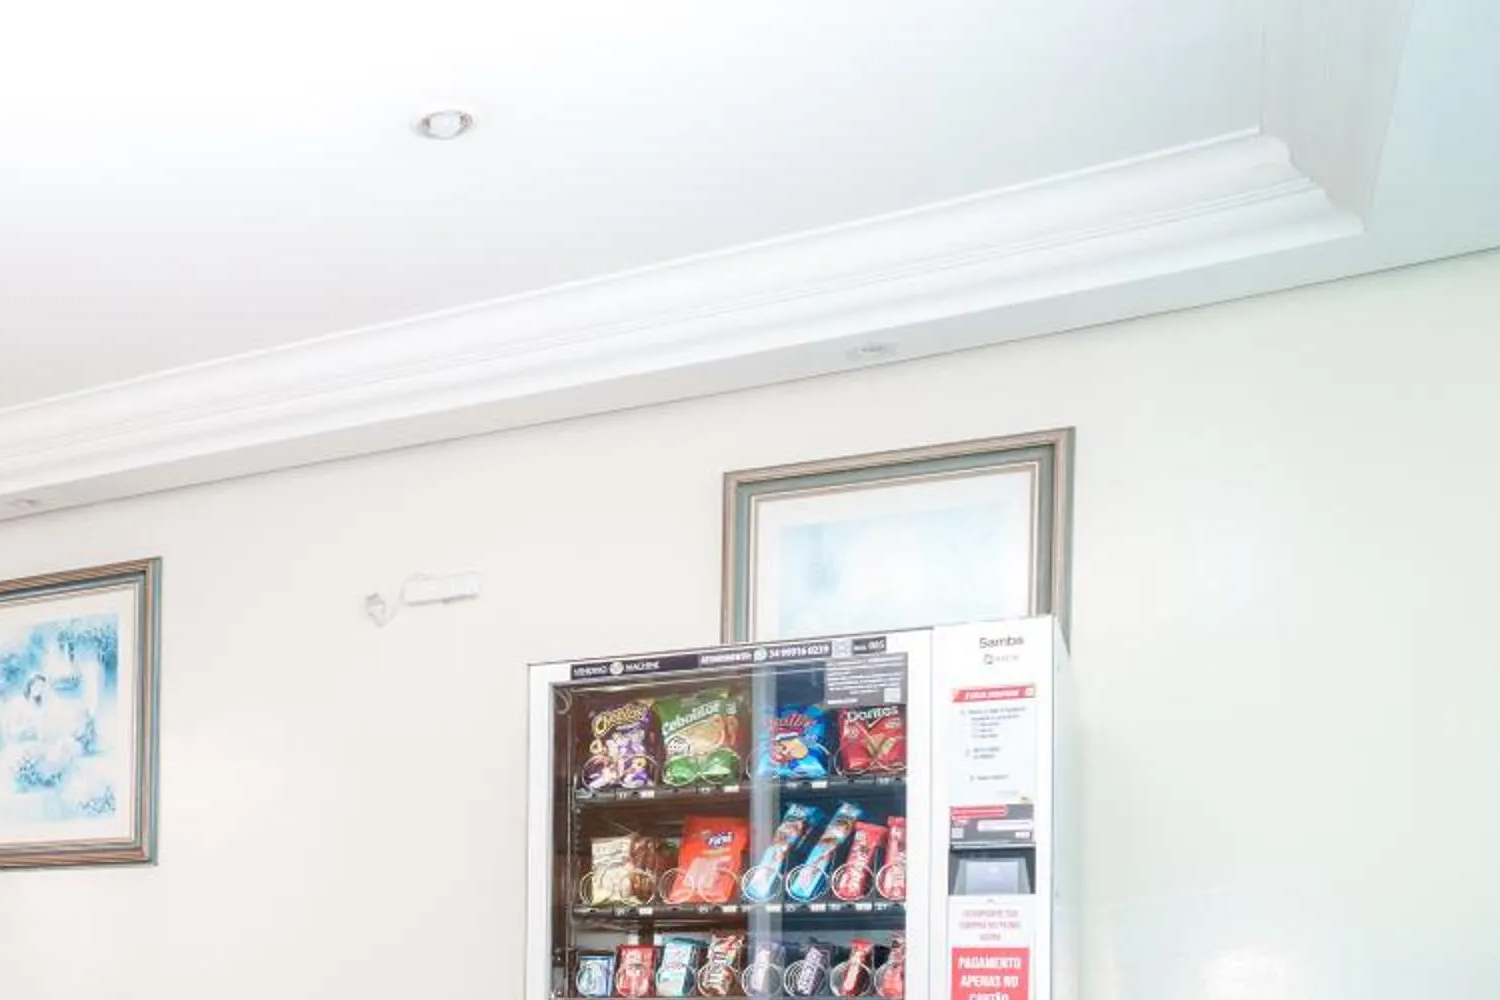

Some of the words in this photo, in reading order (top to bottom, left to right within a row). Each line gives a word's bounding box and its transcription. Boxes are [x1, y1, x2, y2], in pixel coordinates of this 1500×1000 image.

[979, 636, 1024, 649] Samba
[847, 705, 900, 722] Doritos
[958, 956, 1022, 970] PAGAMENTO
[960, 974, 1001, 989] APENAS
[1003, 975, 1020, 988] NO
